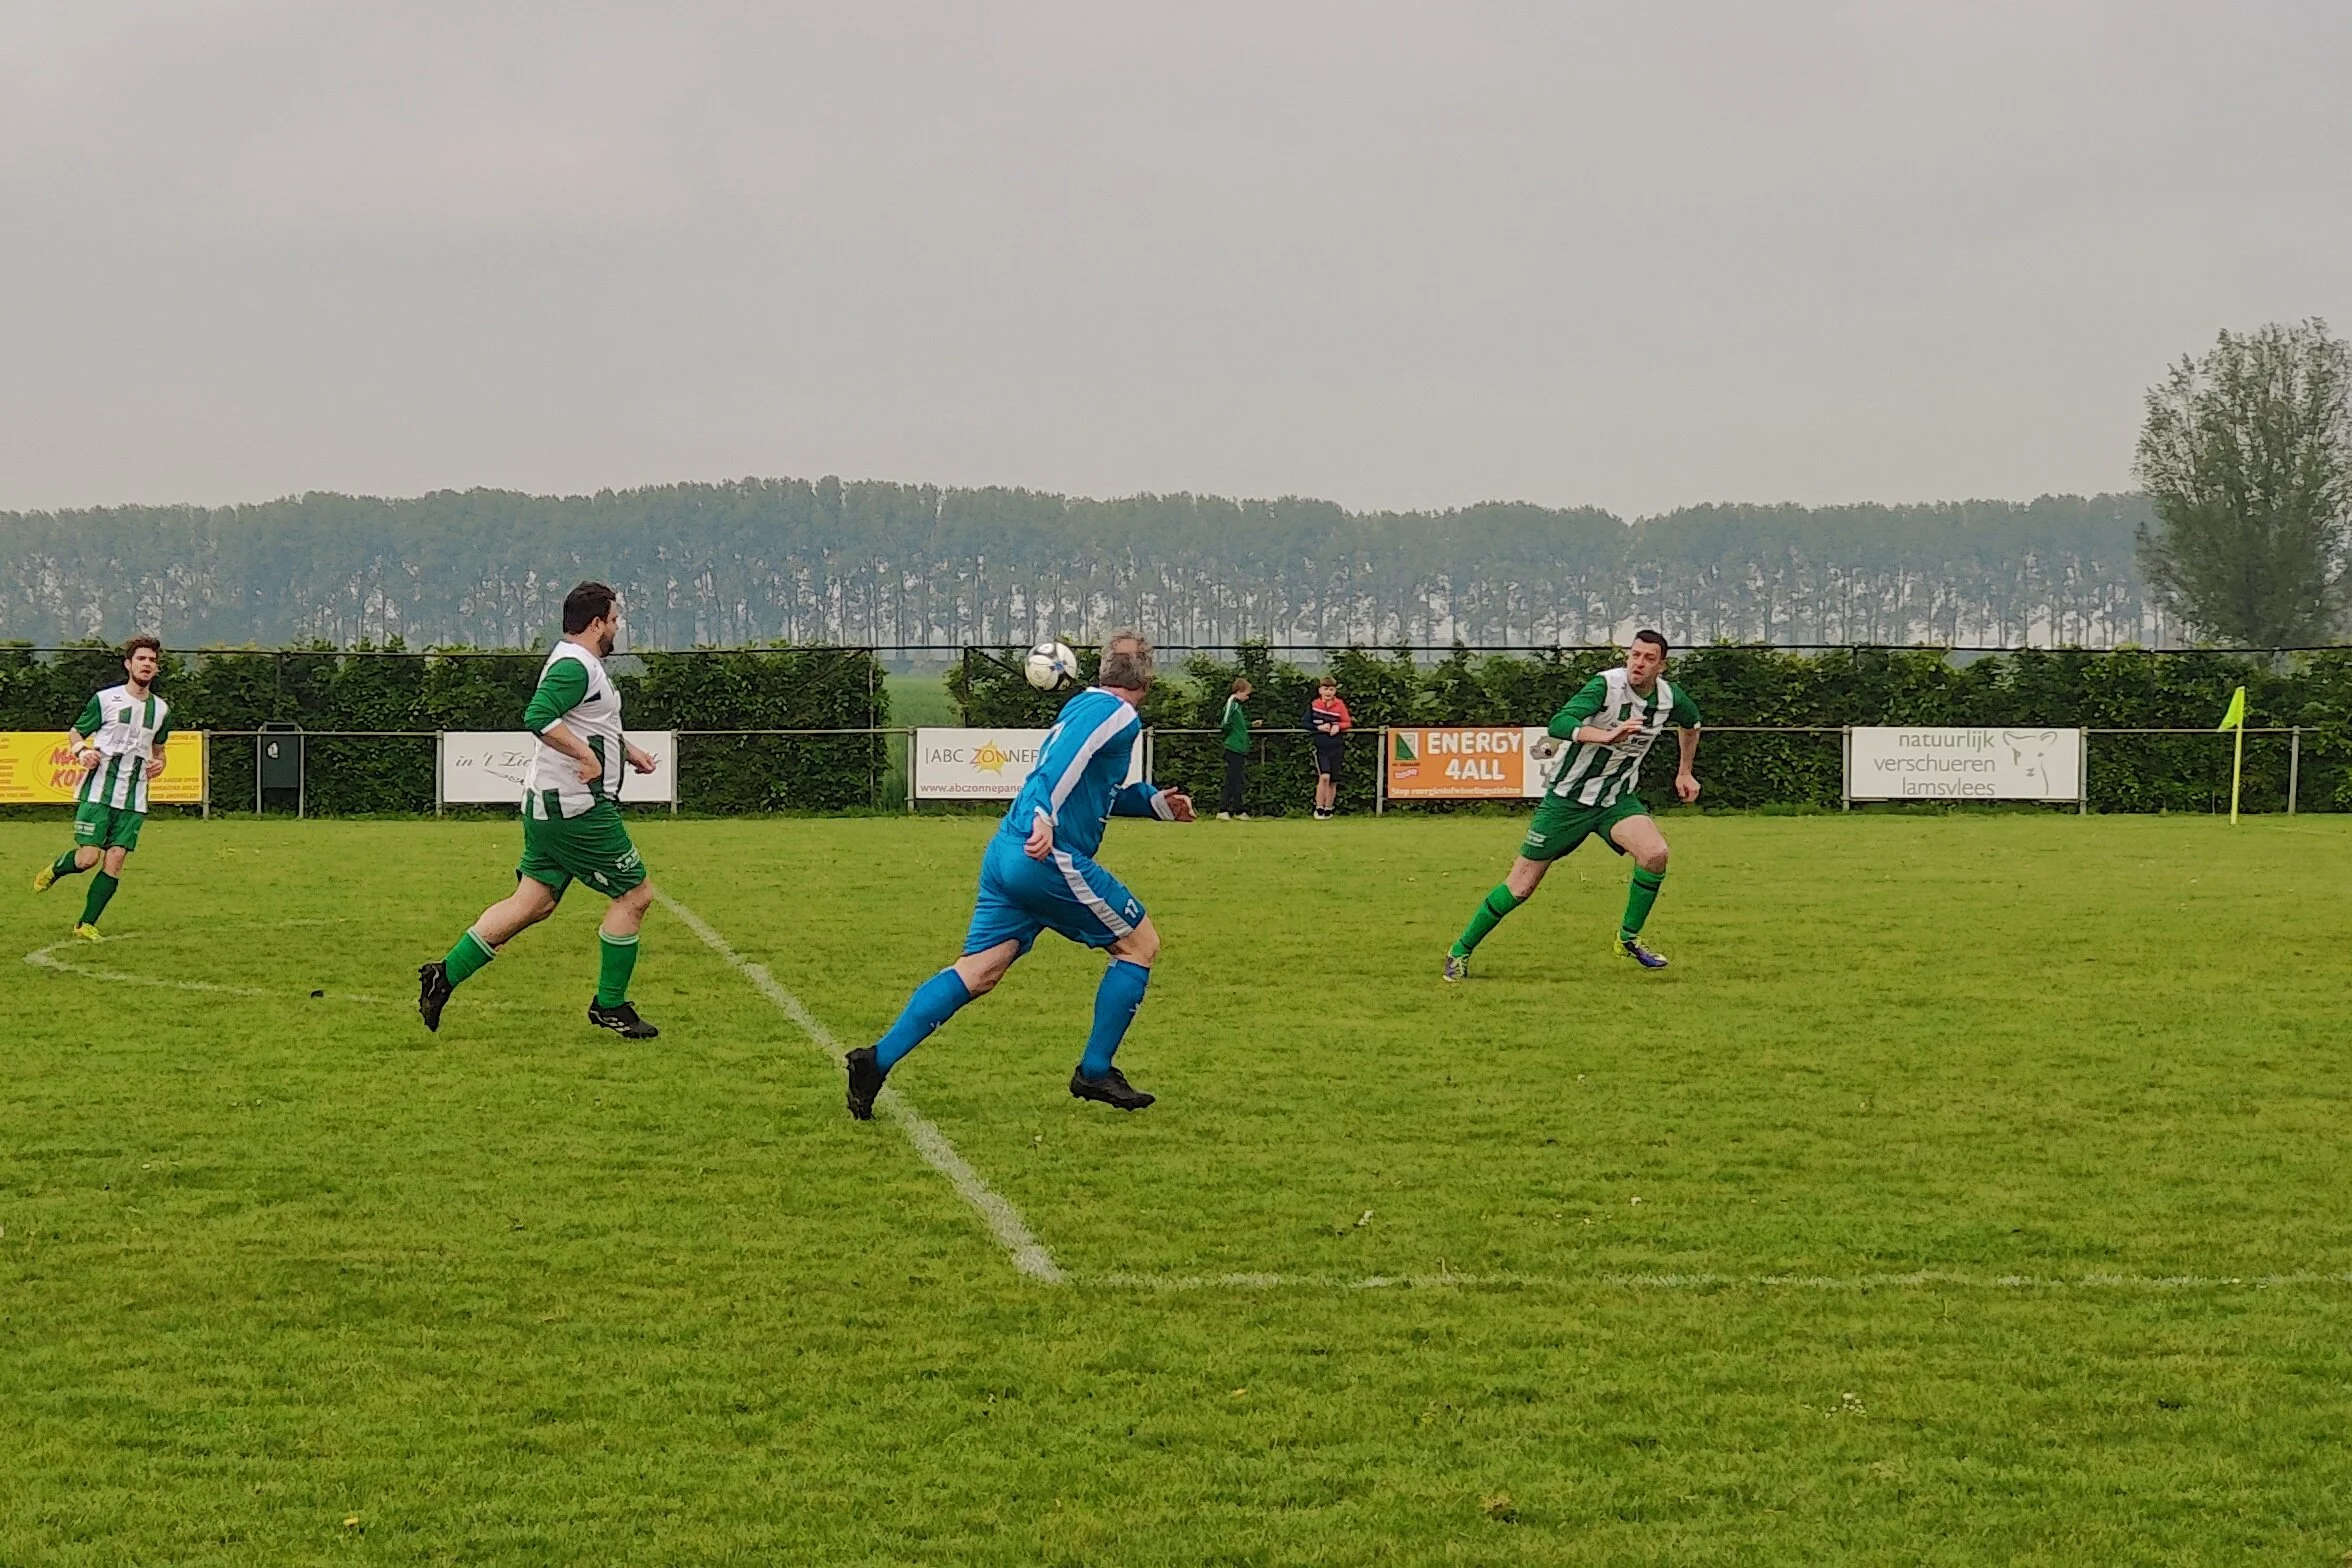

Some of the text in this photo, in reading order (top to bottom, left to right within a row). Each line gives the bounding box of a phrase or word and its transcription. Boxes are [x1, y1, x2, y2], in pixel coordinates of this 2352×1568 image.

[1427, 731, 1522, 755] ENERGY
[1898, 730, 1995, 753] natuurlijk
[456, 755, 473, 767] in
[1444, 758, 1506, 780] 4ALL
[1874, 753, 1995, 773] verschueren
[1902, 776, 1996, 797] lamsvlees
[1124, 898, 1139, 919] 17
